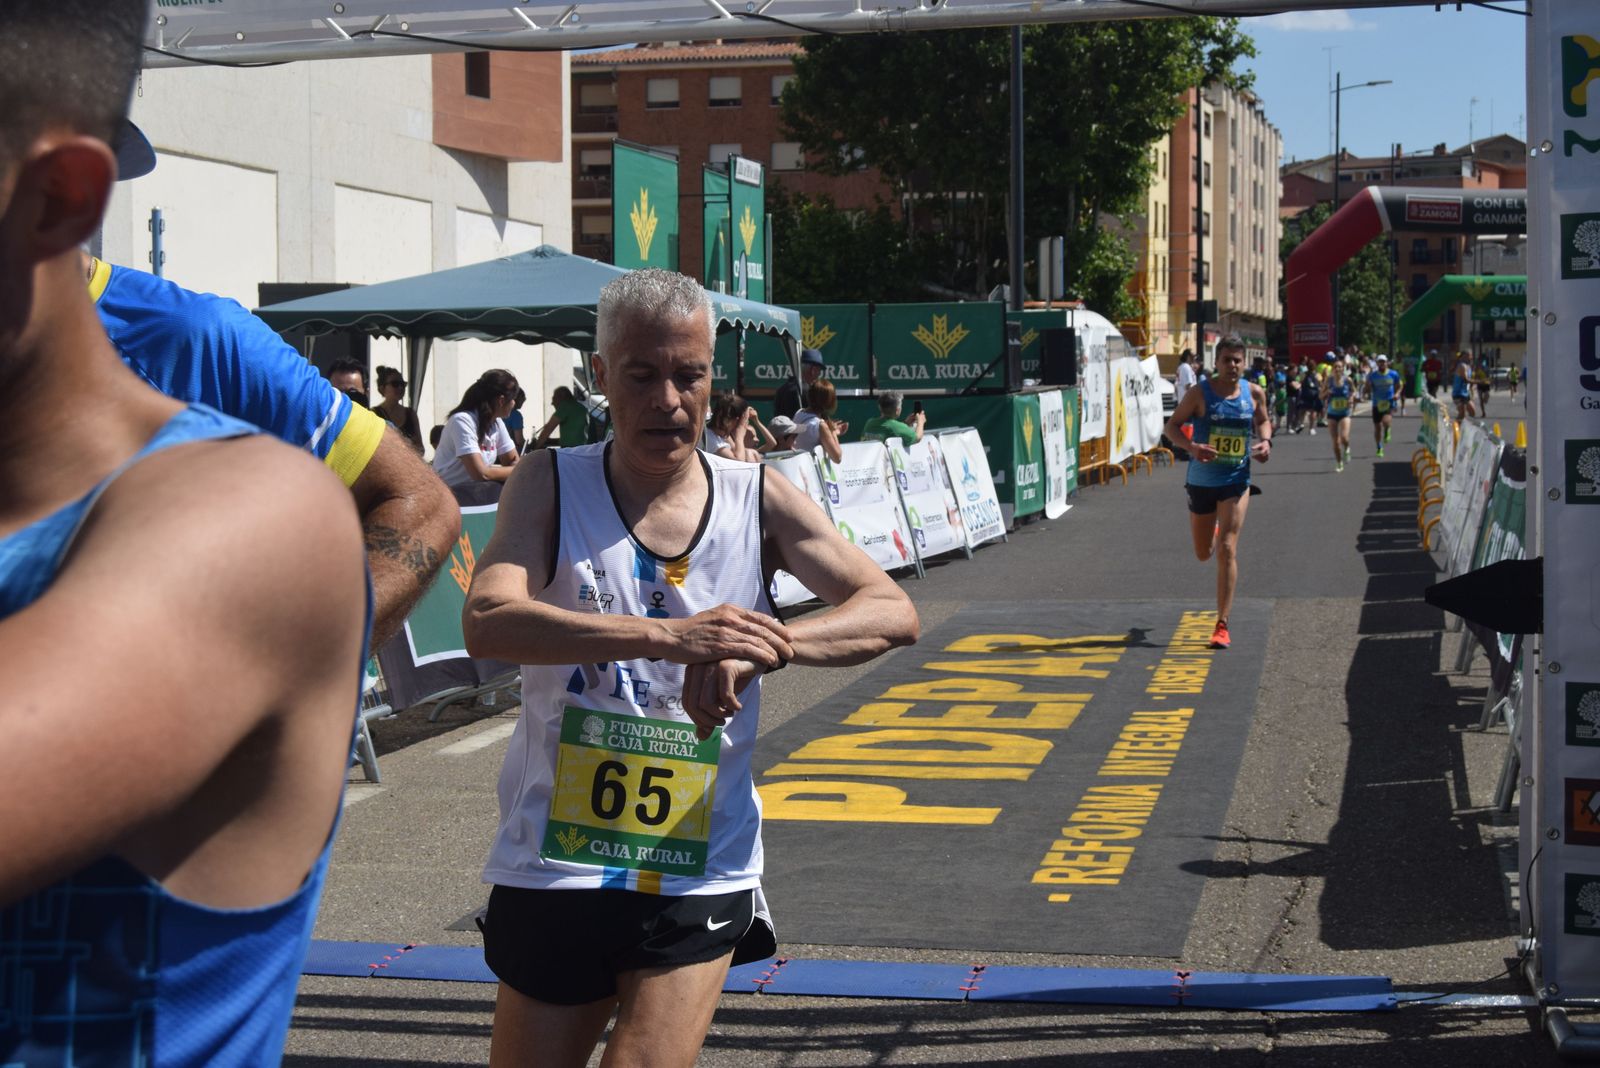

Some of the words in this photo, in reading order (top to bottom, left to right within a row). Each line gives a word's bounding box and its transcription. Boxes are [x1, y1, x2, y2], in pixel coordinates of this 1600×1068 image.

[1473, 197, 1502, 209] CON
[1505, 198, 1521, 209] EL
[755, 364, 795, 380] CAJA
[888, 363, 930, 380] CAJA
[935, 363, 995, 380] RURAL
[1214, 437, 1241, 453] 130
[609, 720, 700, 745] FUNDACION
[756, 634, 1127, 825] PIDEPAR
[608, 735, 644, 751] CAJA
[647, 740, 698, 758] RURAL
[591, 760, 675, 826] 65
[1030, 783, 1164, 885] REFORMA
[1097, 708, 1195, 776] INTEGRAL
[590, 839, 632, 860] CAJA
[635, 846, 697, 866] RURAL
